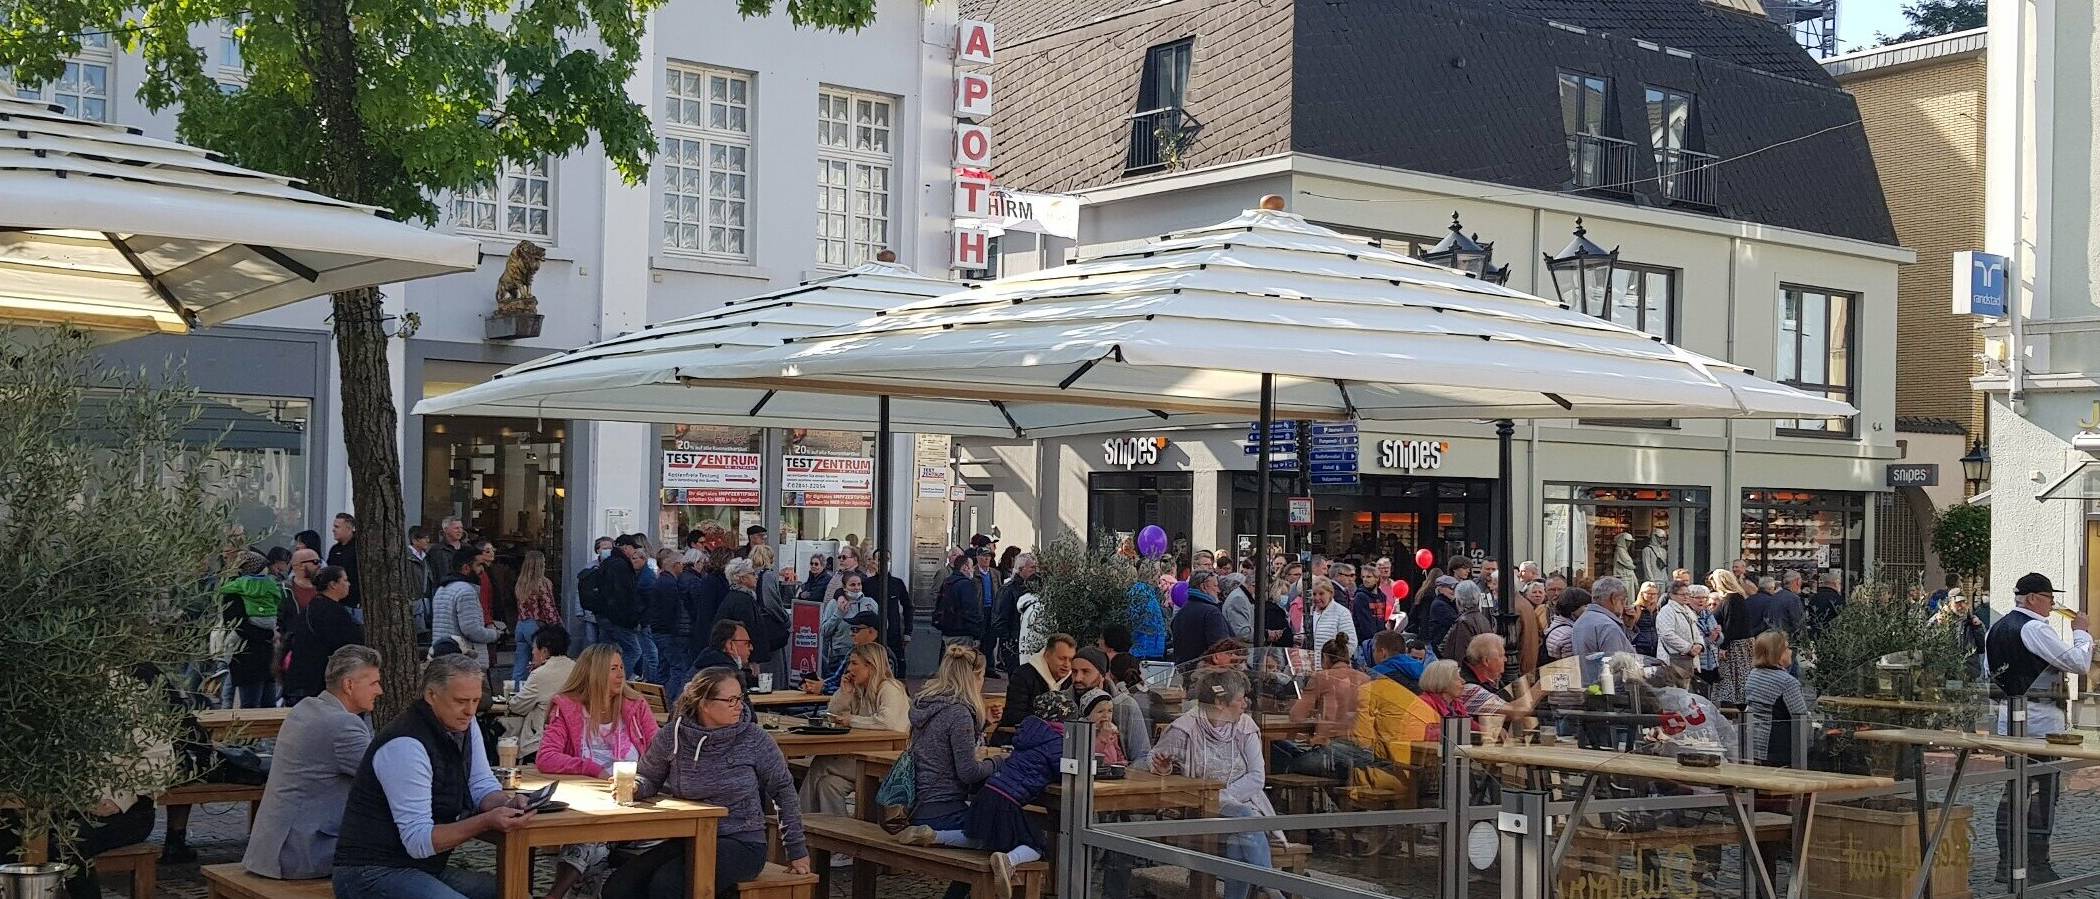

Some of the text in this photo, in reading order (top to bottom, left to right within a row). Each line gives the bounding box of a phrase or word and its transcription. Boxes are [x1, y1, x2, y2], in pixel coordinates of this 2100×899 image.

[1973, 293, 2001, 305] randstad
[1104, 437, 1158, 470] snipes
[1382, 439, 1441, 474] snipes
[1893, 468, 1927, 483] snipes
